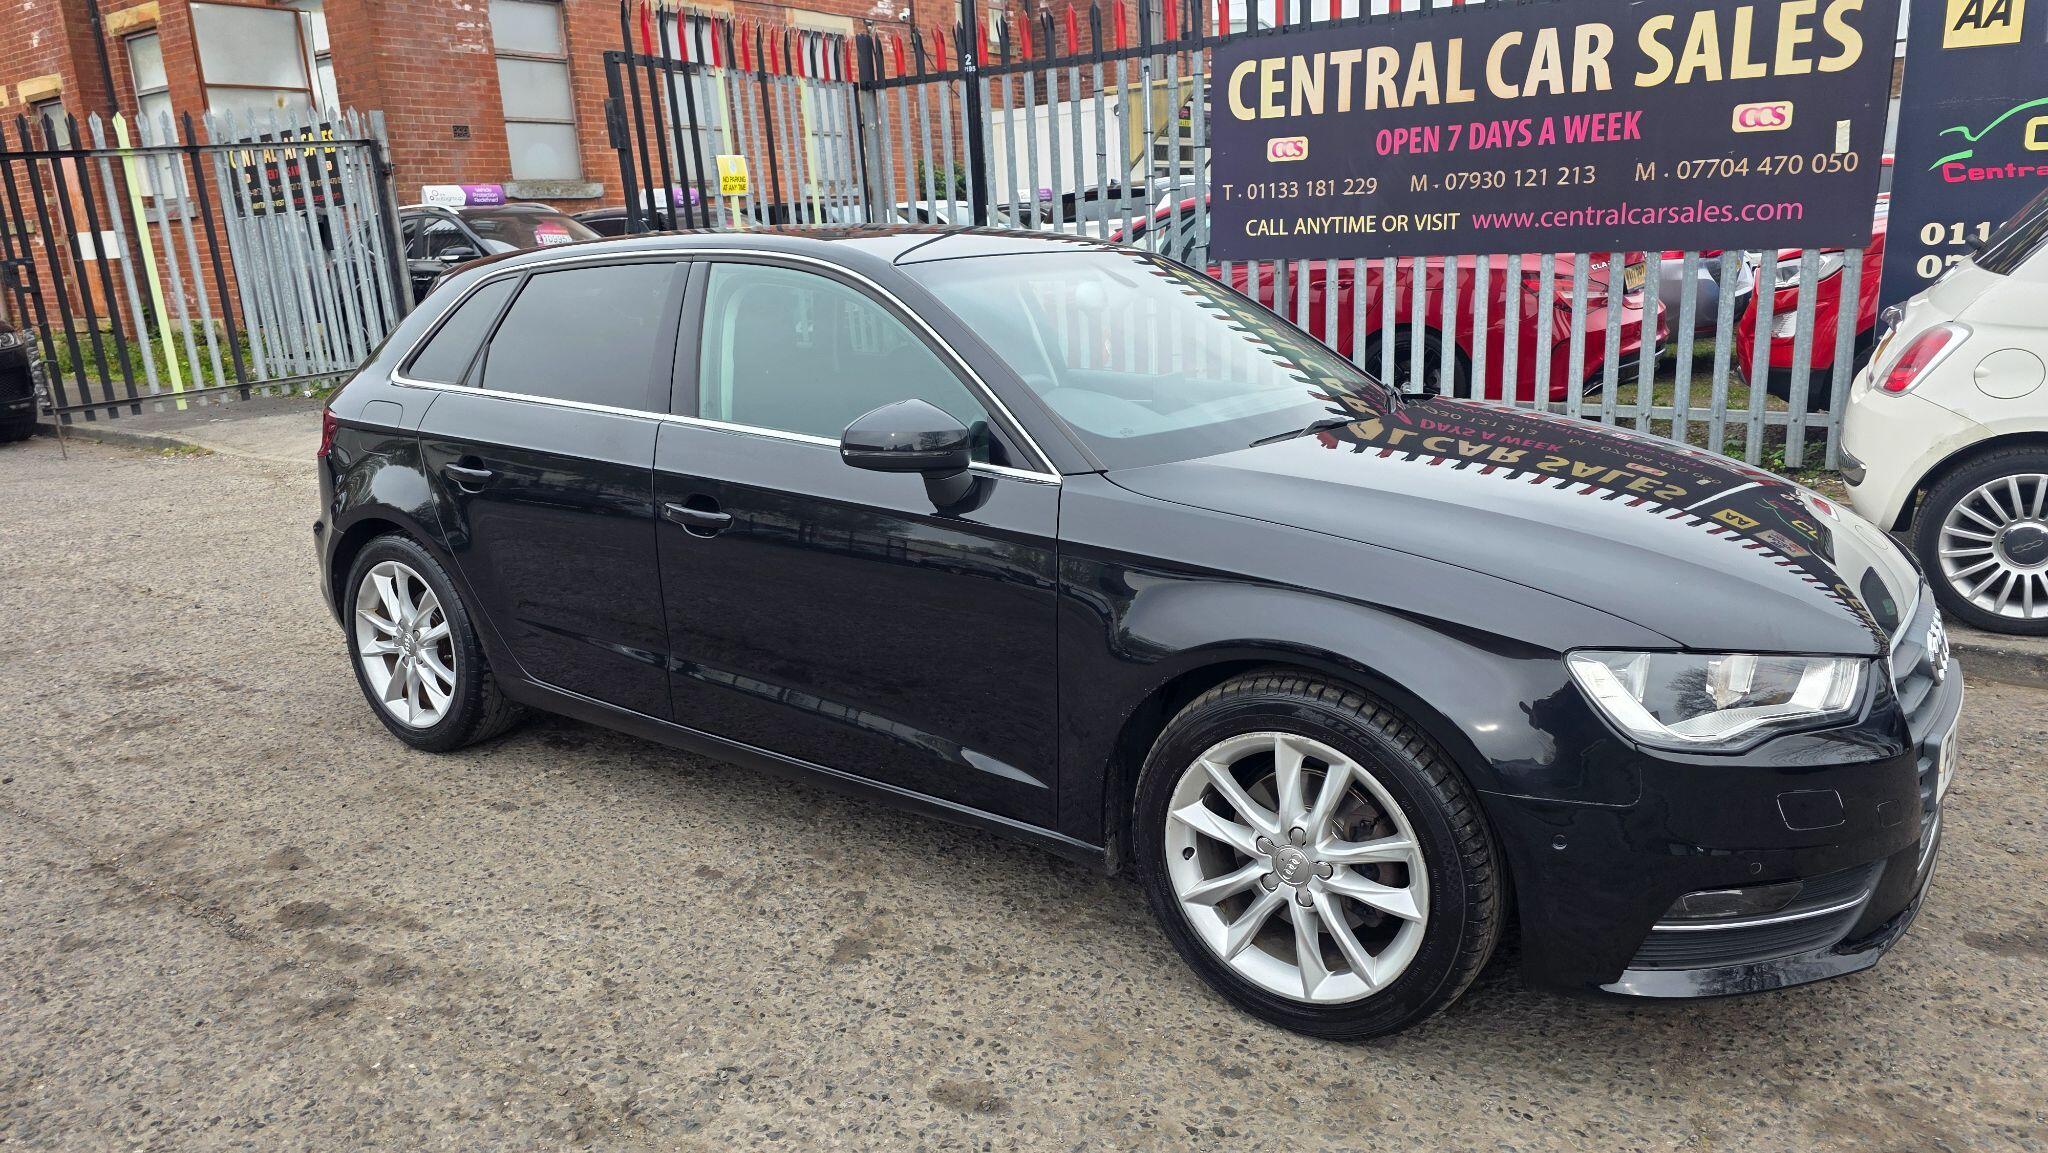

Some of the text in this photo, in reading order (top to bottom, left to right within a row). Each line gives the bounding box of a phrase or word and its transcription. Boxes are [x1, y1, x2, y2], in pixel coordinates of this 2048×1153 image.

[1953, 0, 2012, 31] AA
[965, 54, 972, 65] 2
[1228, 0, 1864, 120] CENTRAL CAR SALES
[1738, 105, 1786, 128] CCS
[1375, 110, 1643, 156] OPEN 7 DAYS A WEEK
[1271, 140, 1304, 159] CCS
[1445, 170, 1506, 191] 07930
[1514, 168, 1547, 187] 121
[1556, 165, 1596, 186] 213
[1676, 157, 1749, 180] 07704
[1757, 155, 1803, 176] 470
[1811, 152, 1859, 173] 050
[1247, 181, 1299, 200] 01133
[1306, 179, 1335, 197] 181
[1342, 177, 1378, 196] 229
[1245, 199, 1803, 237] CALL ANYTIME OR VISIT www.centralcarsales.com
